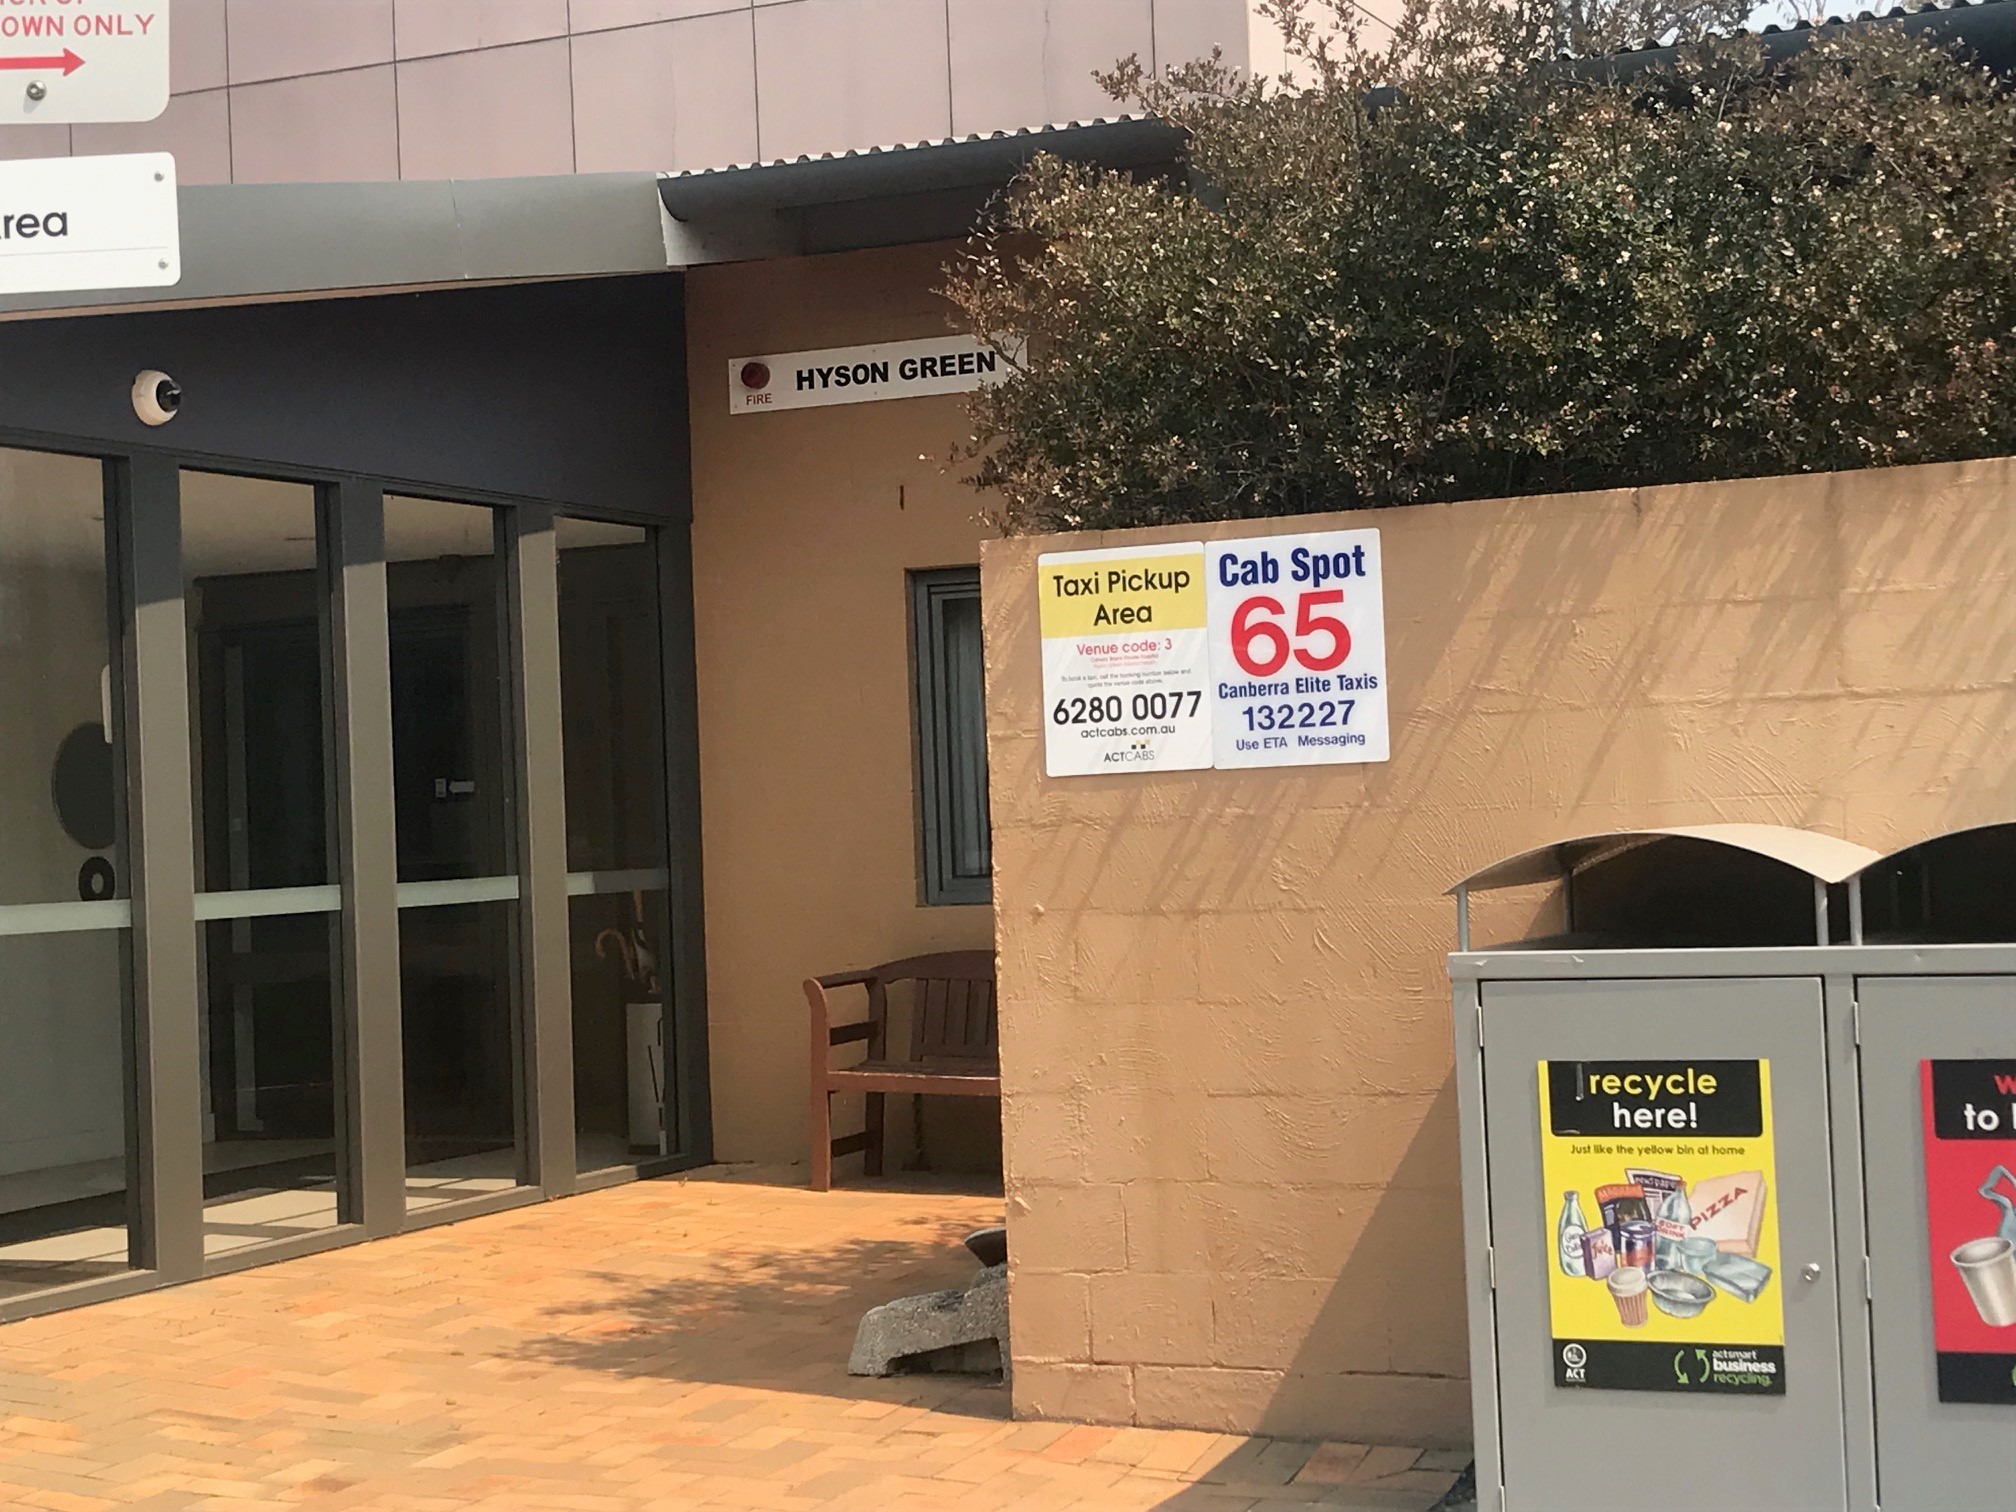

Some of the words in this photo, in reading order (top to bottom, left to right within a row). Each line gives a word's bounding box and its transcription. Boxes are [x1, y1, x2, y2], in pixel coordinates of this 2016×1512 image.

[73, 14, 155, 36] ONLY
[0, 211, 68, 239] rea
[796, 361, 889, 391] HYSON
[899, 351, 996, 380] GREEN
[746, 393, 772, 406] FIRE
[1219, 551, 1279, 587] Cab
[1291, 545, 1366, 588] Spot
[1053, 571, 1100, 598] Taxi
[1108, 568, 1190, 594] Pickup
[1093, 604, 1152, 626] Area
[1231, 589, 1352, 677] 65
[1076, 643, 1118, 656] Venue
[1122, 640, 1160, 652] code:
[1164, 638, 1173, 650] 3
[1218, 681, 1290, 699] Canberra
[1295, 677, 1331, 694] Elite
[1336, 673, 1378, 691] Taxis
[1053, 695, 1122, 725] 6280
[1132, 690, 1202, 721] 0077
[1242, 699, 1356, 731] 132227
[1081, 724, 1176, 738] actcabs.com.au
[1236, 738, 1259, 751] Use
[1264, 736, 1288, 749] ETA
[1297, 732, 1366, 748] Messaging
[1103, 750, 1155, 762] ACTCABS
[1589, 1067, 1718, 1100] recycle
[1613, 1102, 1698, 1128] here!
[1964, 1103, 1999, 1131] to
[1570, 1144, 1591, 1155] Just
[1593, 1144, 1613, 1155] like
[1616, 1144, 1634, 1155] the
[1637, 1144, 1673, 1157] yellow
[1677, 1144, 1695, 1155] bin
[1697, 1145, 1709, 1155] at
[1712, 1145, 1746, 1156] home
[1690, 1186, 1748, 1230] PIZZA
[1658, 1219, 1685, 1231] SOFT
[1566, 1368, 1586, 1379] ACT
[1712, 1359, 1776, 1374] business
